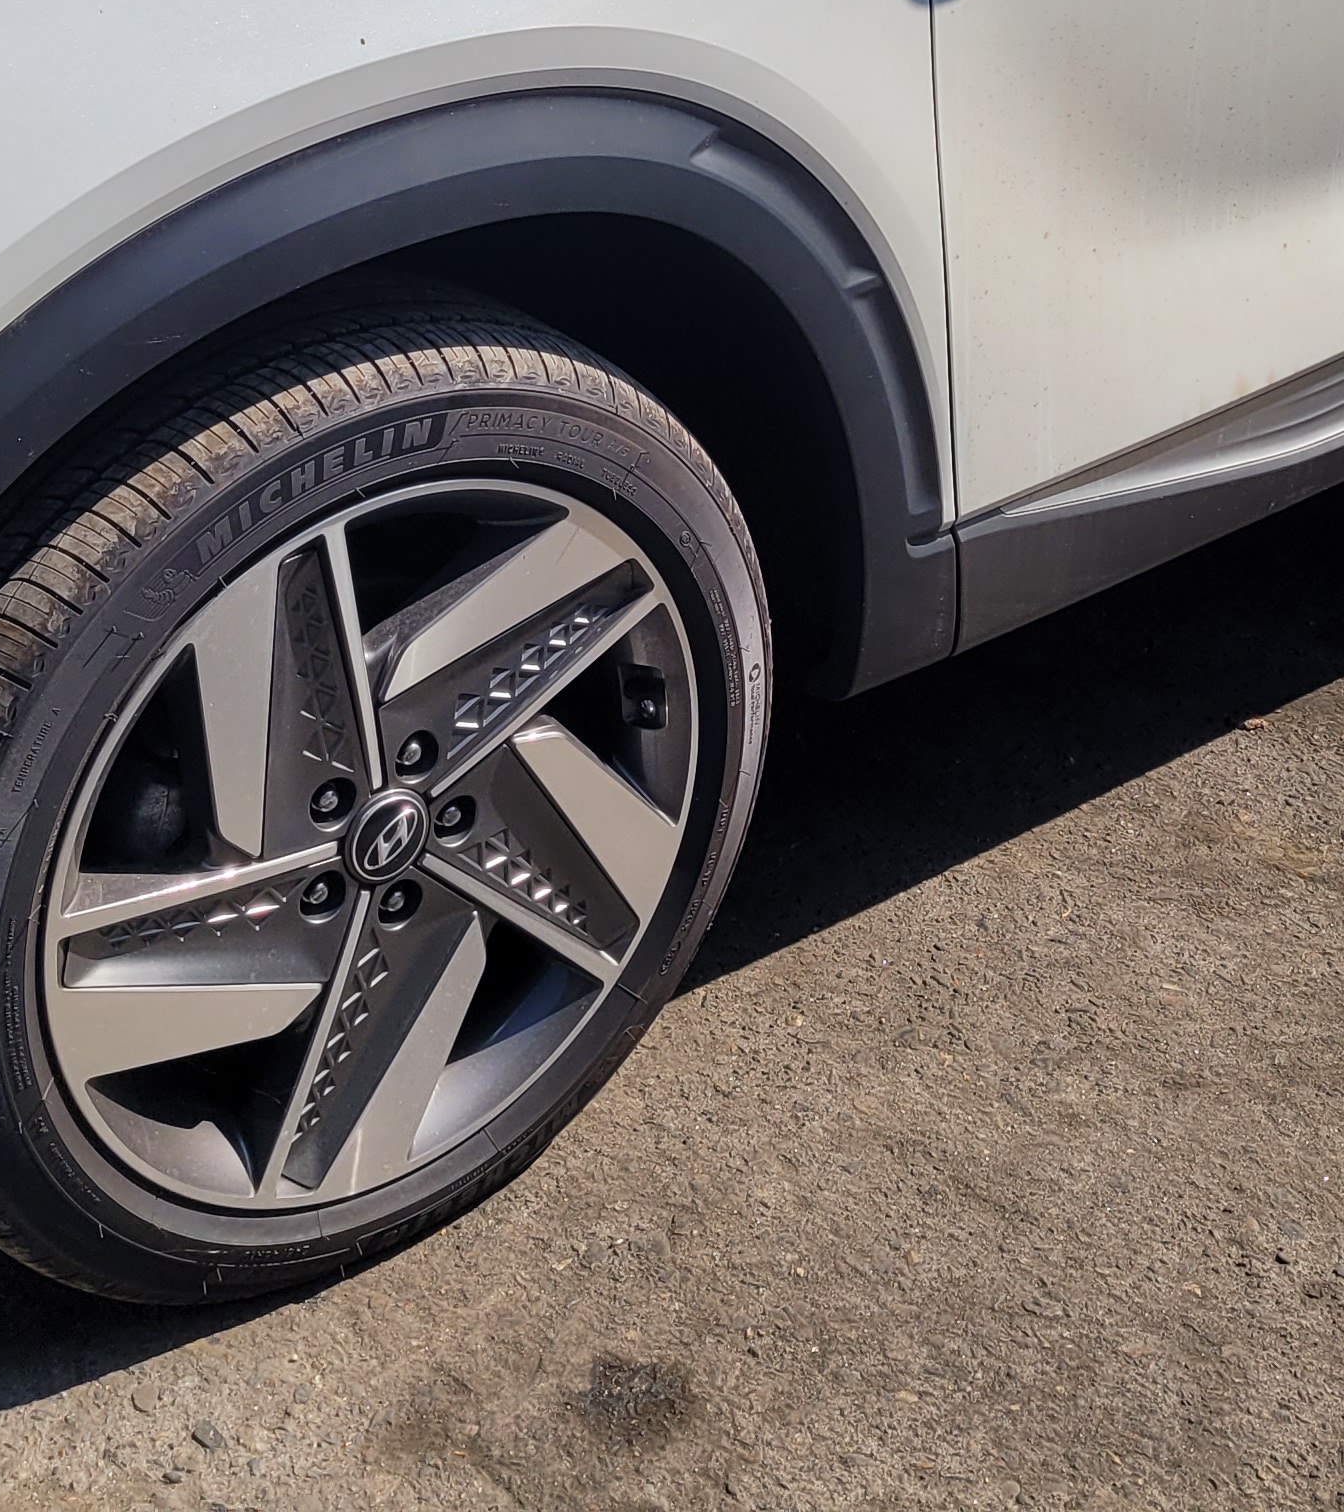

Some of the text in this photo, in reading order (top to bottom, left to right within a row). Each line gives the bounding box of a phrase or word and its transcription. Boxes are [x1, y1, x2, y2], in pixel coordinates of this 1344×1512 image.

[195, 417, 433, 565] MICHELIN
[466, 413, 552, 433] PRIMACY
[558, 420, 605, 449] TOUR
